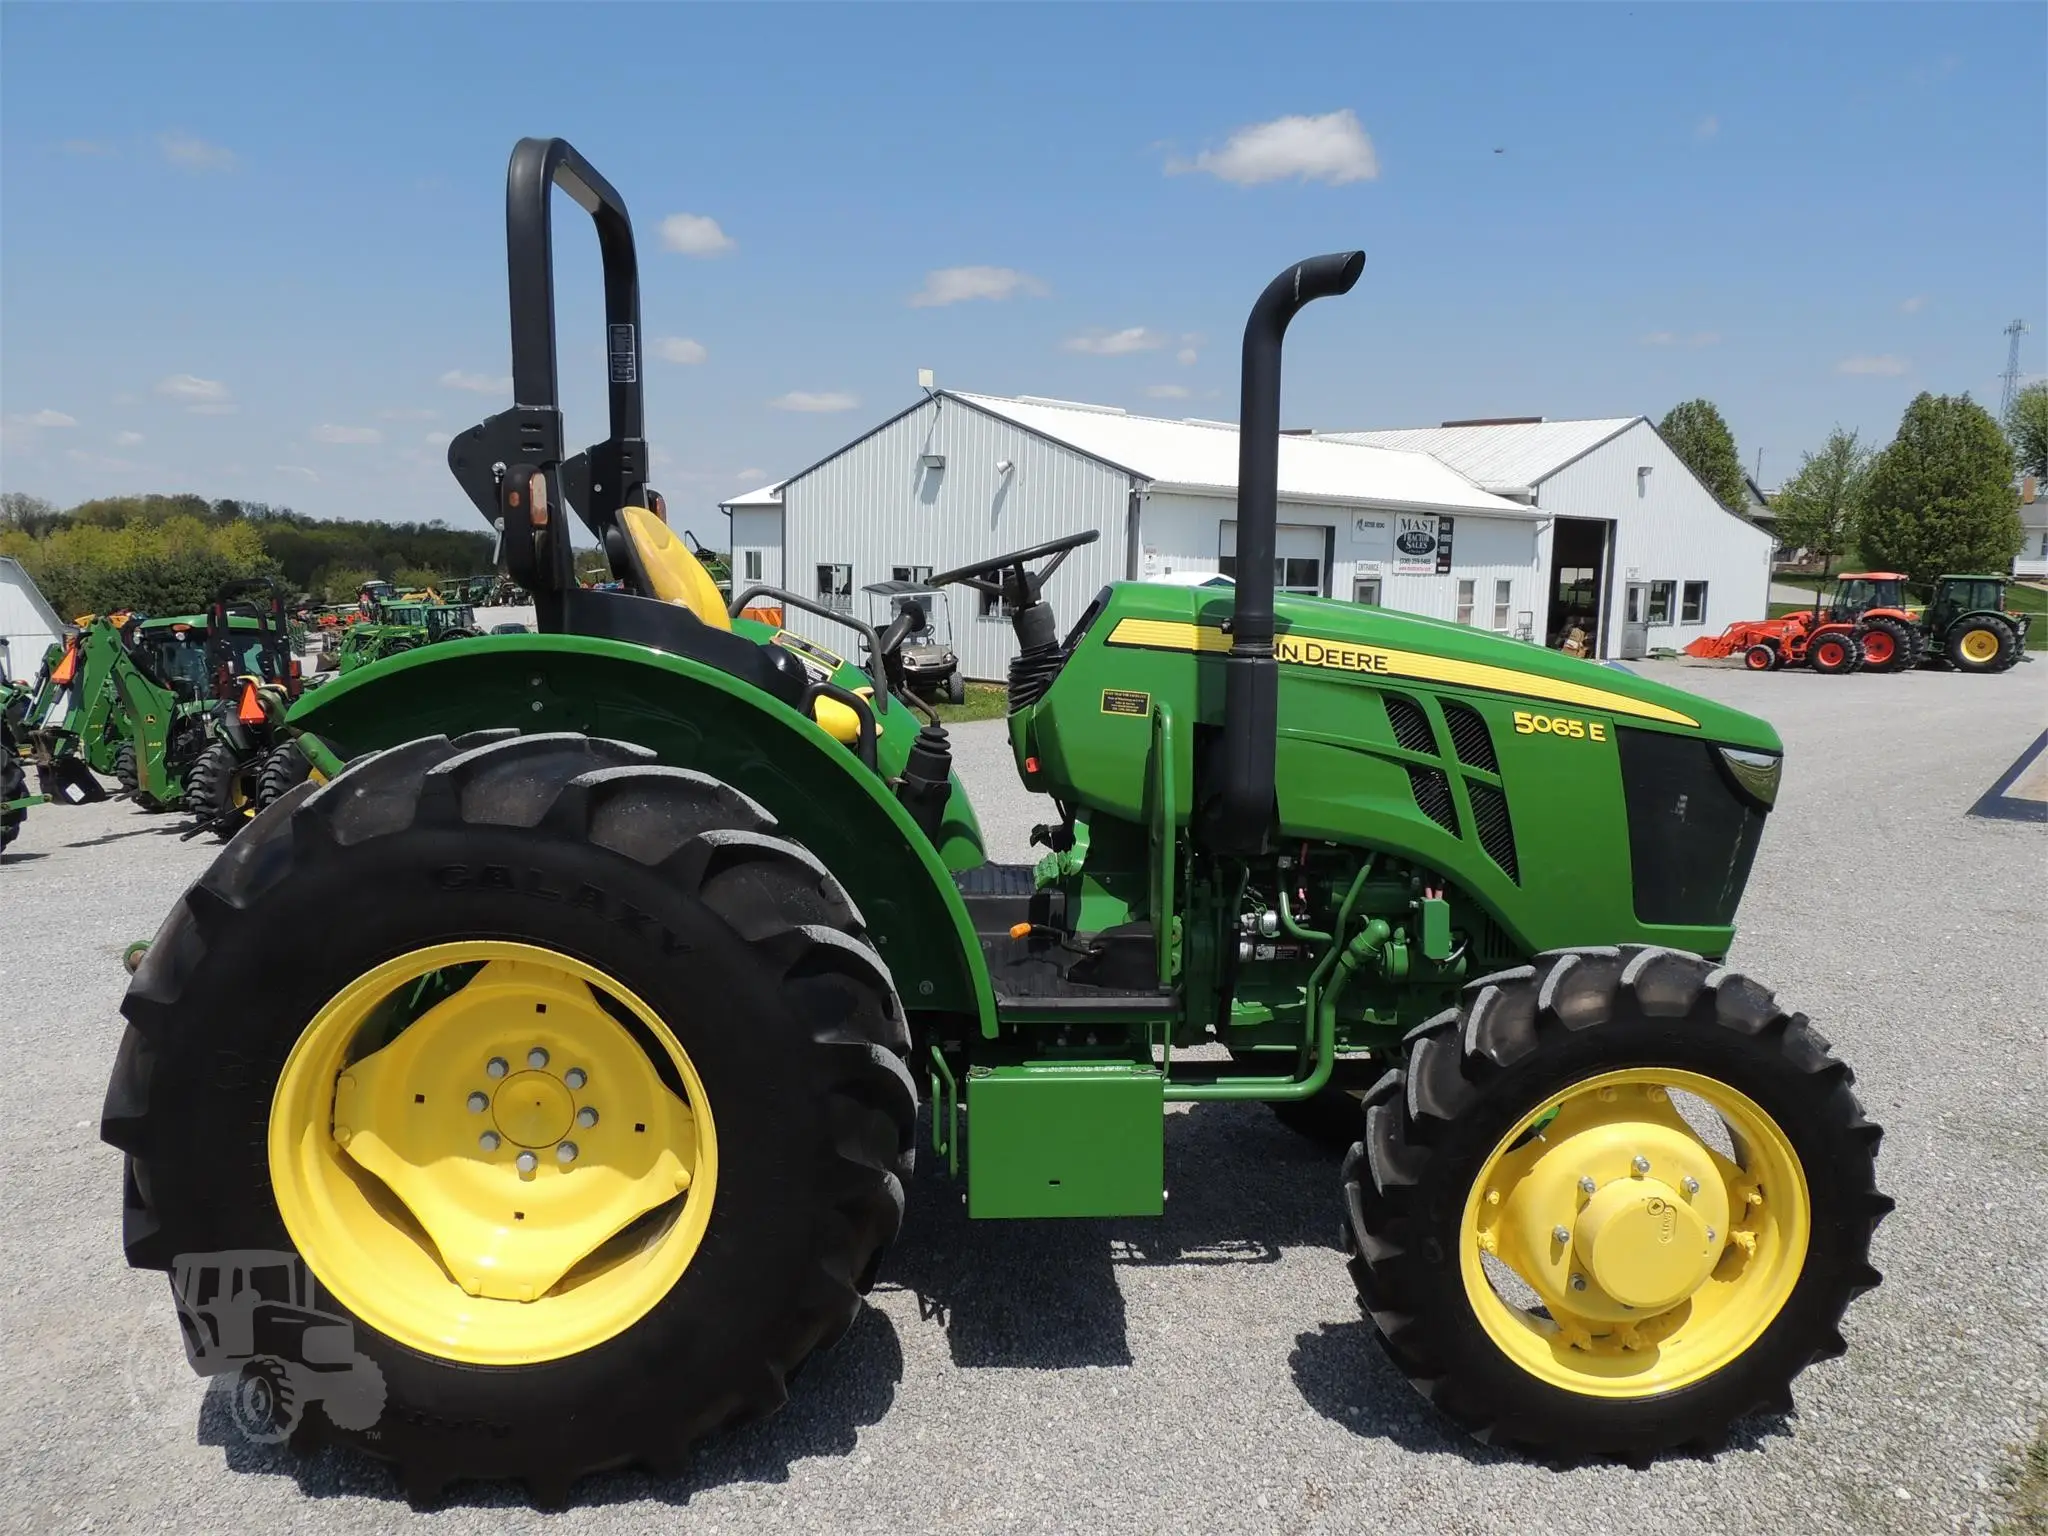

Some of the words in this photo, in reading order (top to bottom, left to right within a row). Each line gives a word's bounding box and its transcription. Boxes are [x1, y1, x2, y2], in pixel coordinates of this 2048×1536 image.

[1400, 518, 1436, 533] MAST
[1403, 532, 1430, 543] TRACTOR
[1405, 541, 1428, 550] SALES
[1358, 563, 1380, 571] ENTRANCE
[1306, 643, 1388, 671] DEERE
[1512, 711, 1585, 738] 5065
[438, 863, 692, 954] GALAXY
